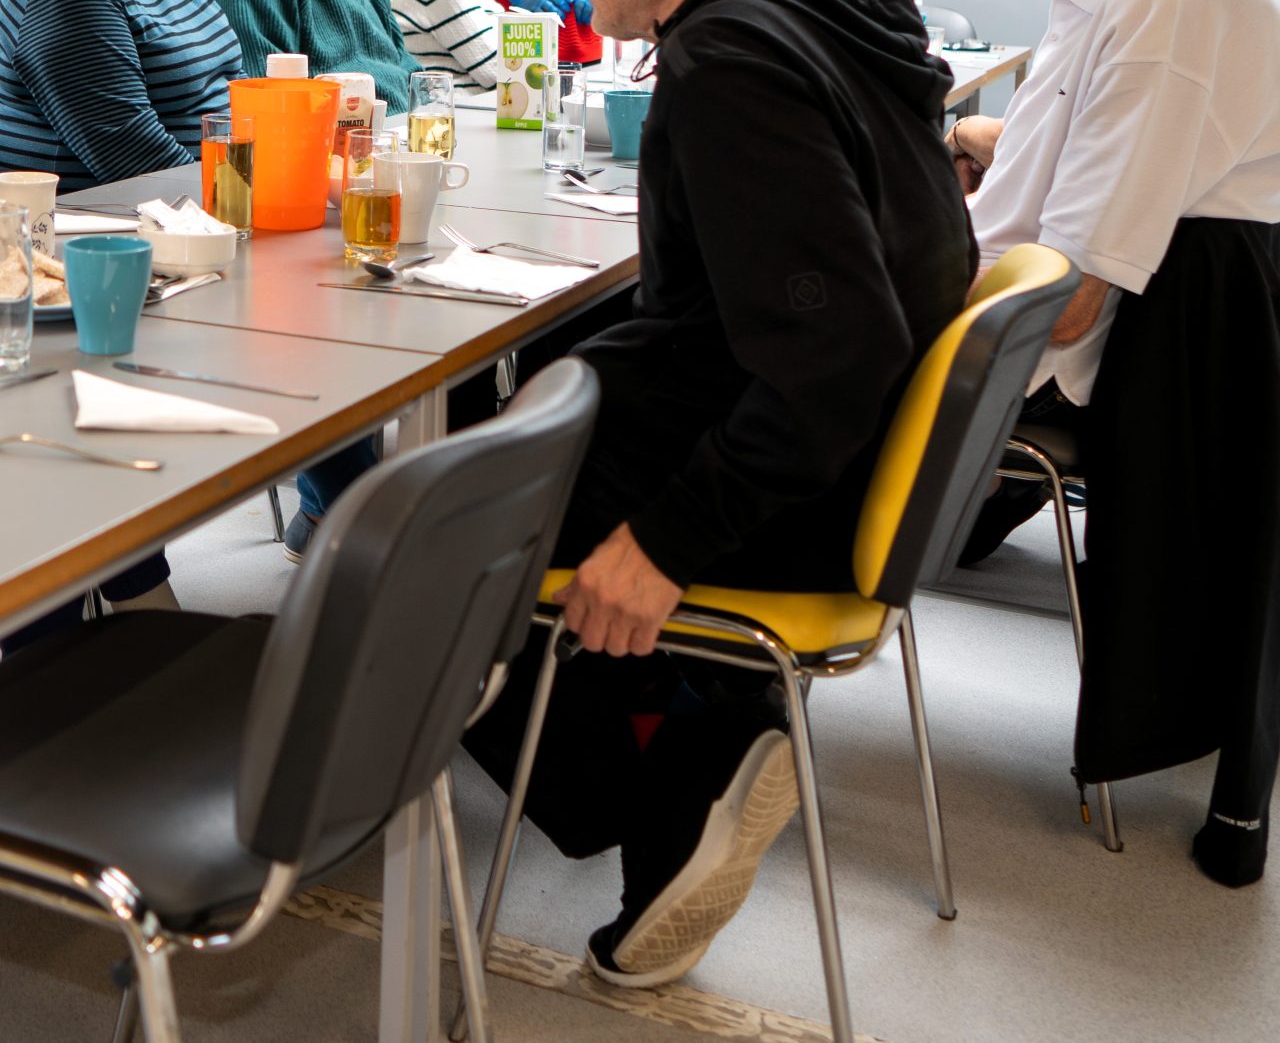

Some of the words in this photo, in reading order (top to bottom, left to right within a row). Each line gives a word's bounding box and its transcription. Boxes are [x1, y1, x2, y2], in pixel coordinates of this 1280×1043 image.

[507, 24, 541, 40] JUICE
[505, 41, 536, 57] 100%
[337, 119, 365, 128] TOMATO
